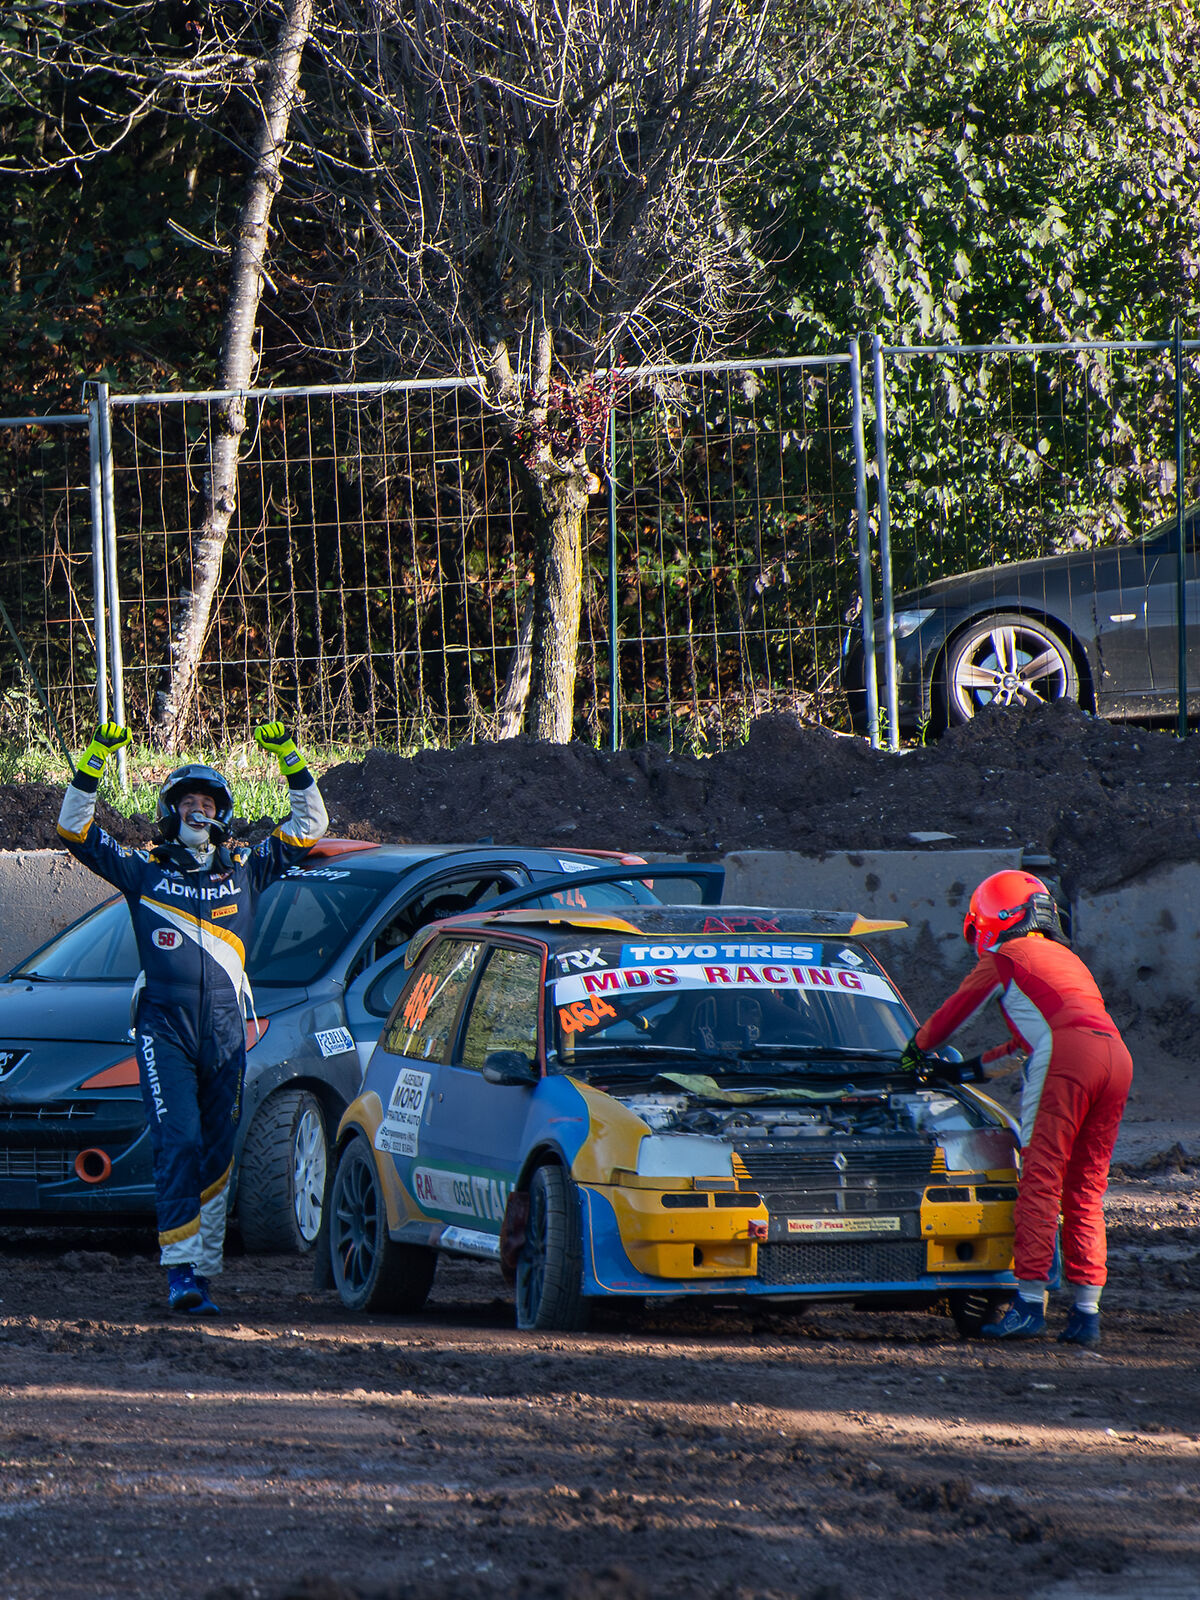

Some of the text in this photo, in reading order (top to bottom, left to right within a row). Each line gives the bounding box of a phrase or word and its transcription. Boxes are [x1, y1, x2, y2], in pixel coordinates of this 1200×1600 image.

[153, 878, 241, 900] ADMIRAL
[158, 930, 176, 947] 58
[556, 947, 608, 973] RX
[630, 945, 814, 960] TOYO TIRES
[582, 966, 863, 993] MDS RACING
[404, 972, 440, 1031] 464
[558, 993, 618, 1034] 464
[141, 1034, 169, 1124] ADMIRAL
[393, 1085, 423, 1111] MORO
[788, 1222, 814, 1230] Mister
[824, 1221, 844, 1230] Pizza
